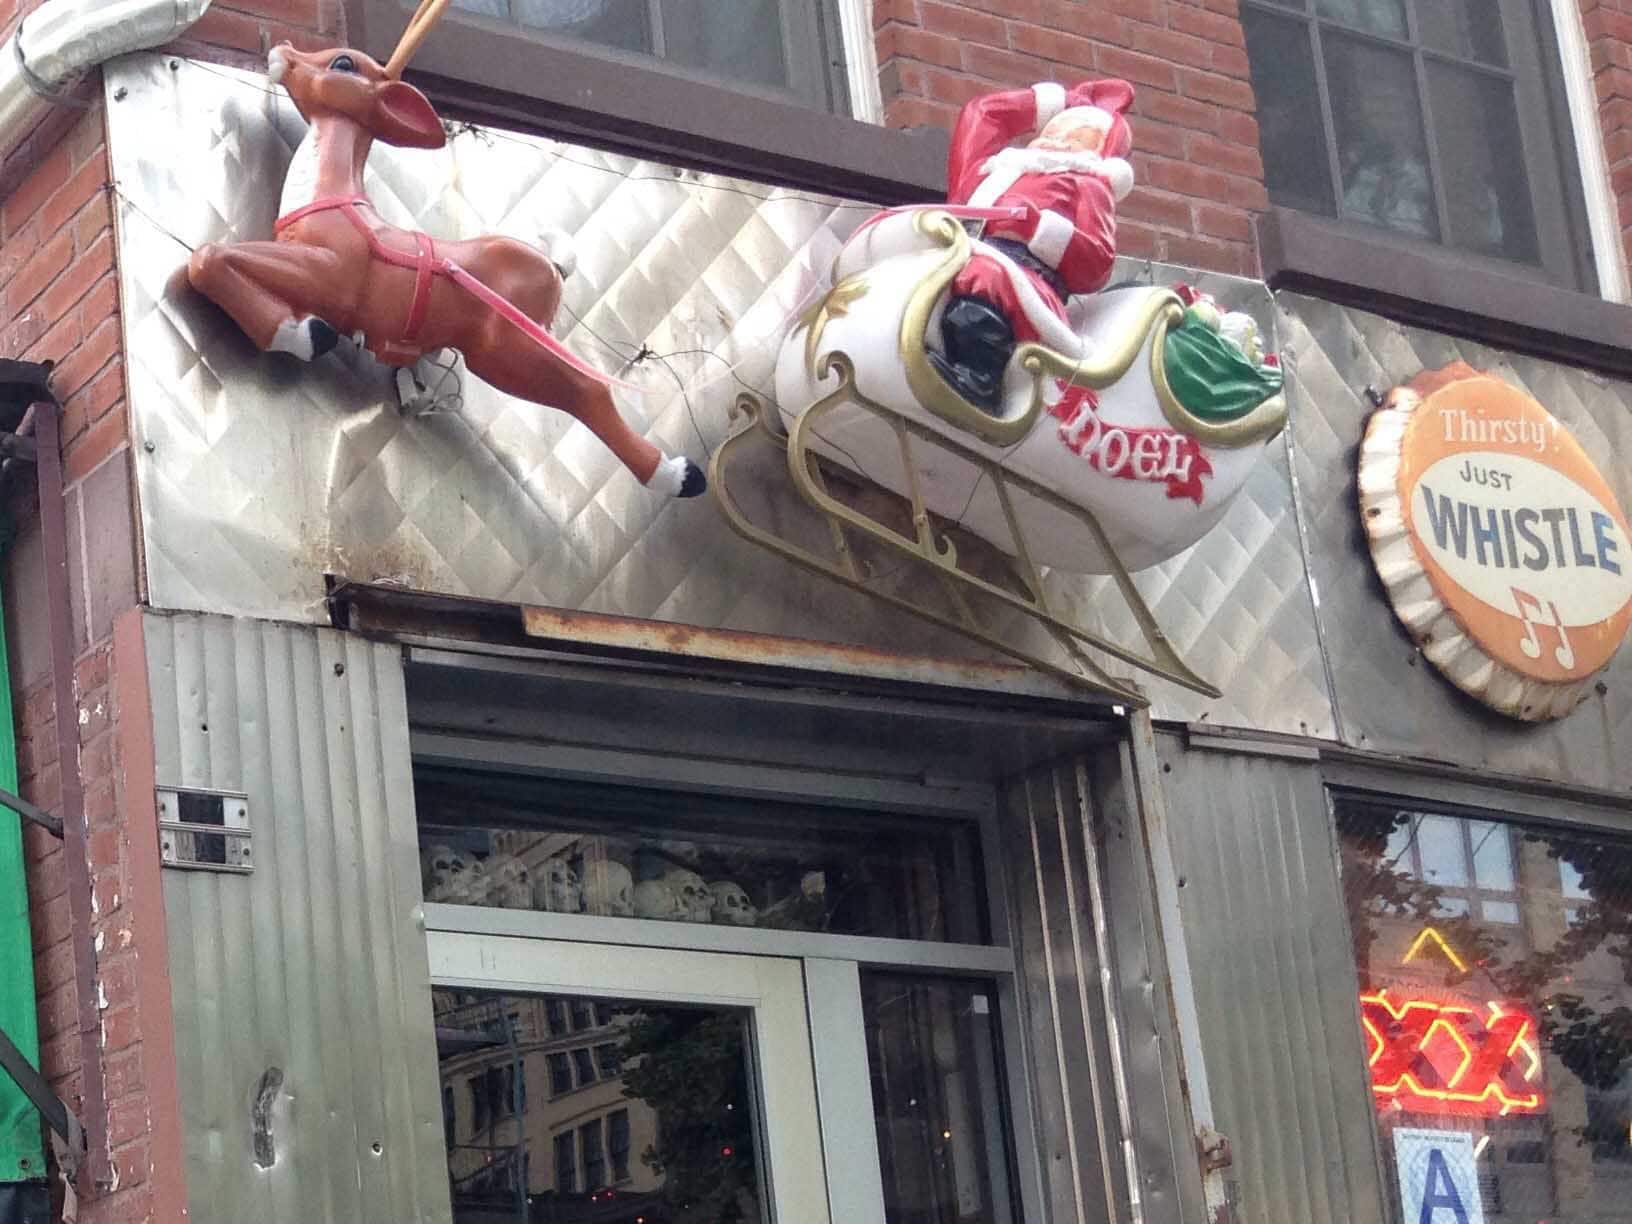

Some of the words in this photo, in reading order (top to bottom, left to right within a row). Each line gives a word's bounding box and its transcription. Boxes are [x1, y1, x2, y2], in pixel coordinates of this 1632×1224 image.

[1060, 398, 1193, 483] NOEL
[1460, 460, 1513, 491] JUST
[1421, 484, 1622, 577] WHISTLE
